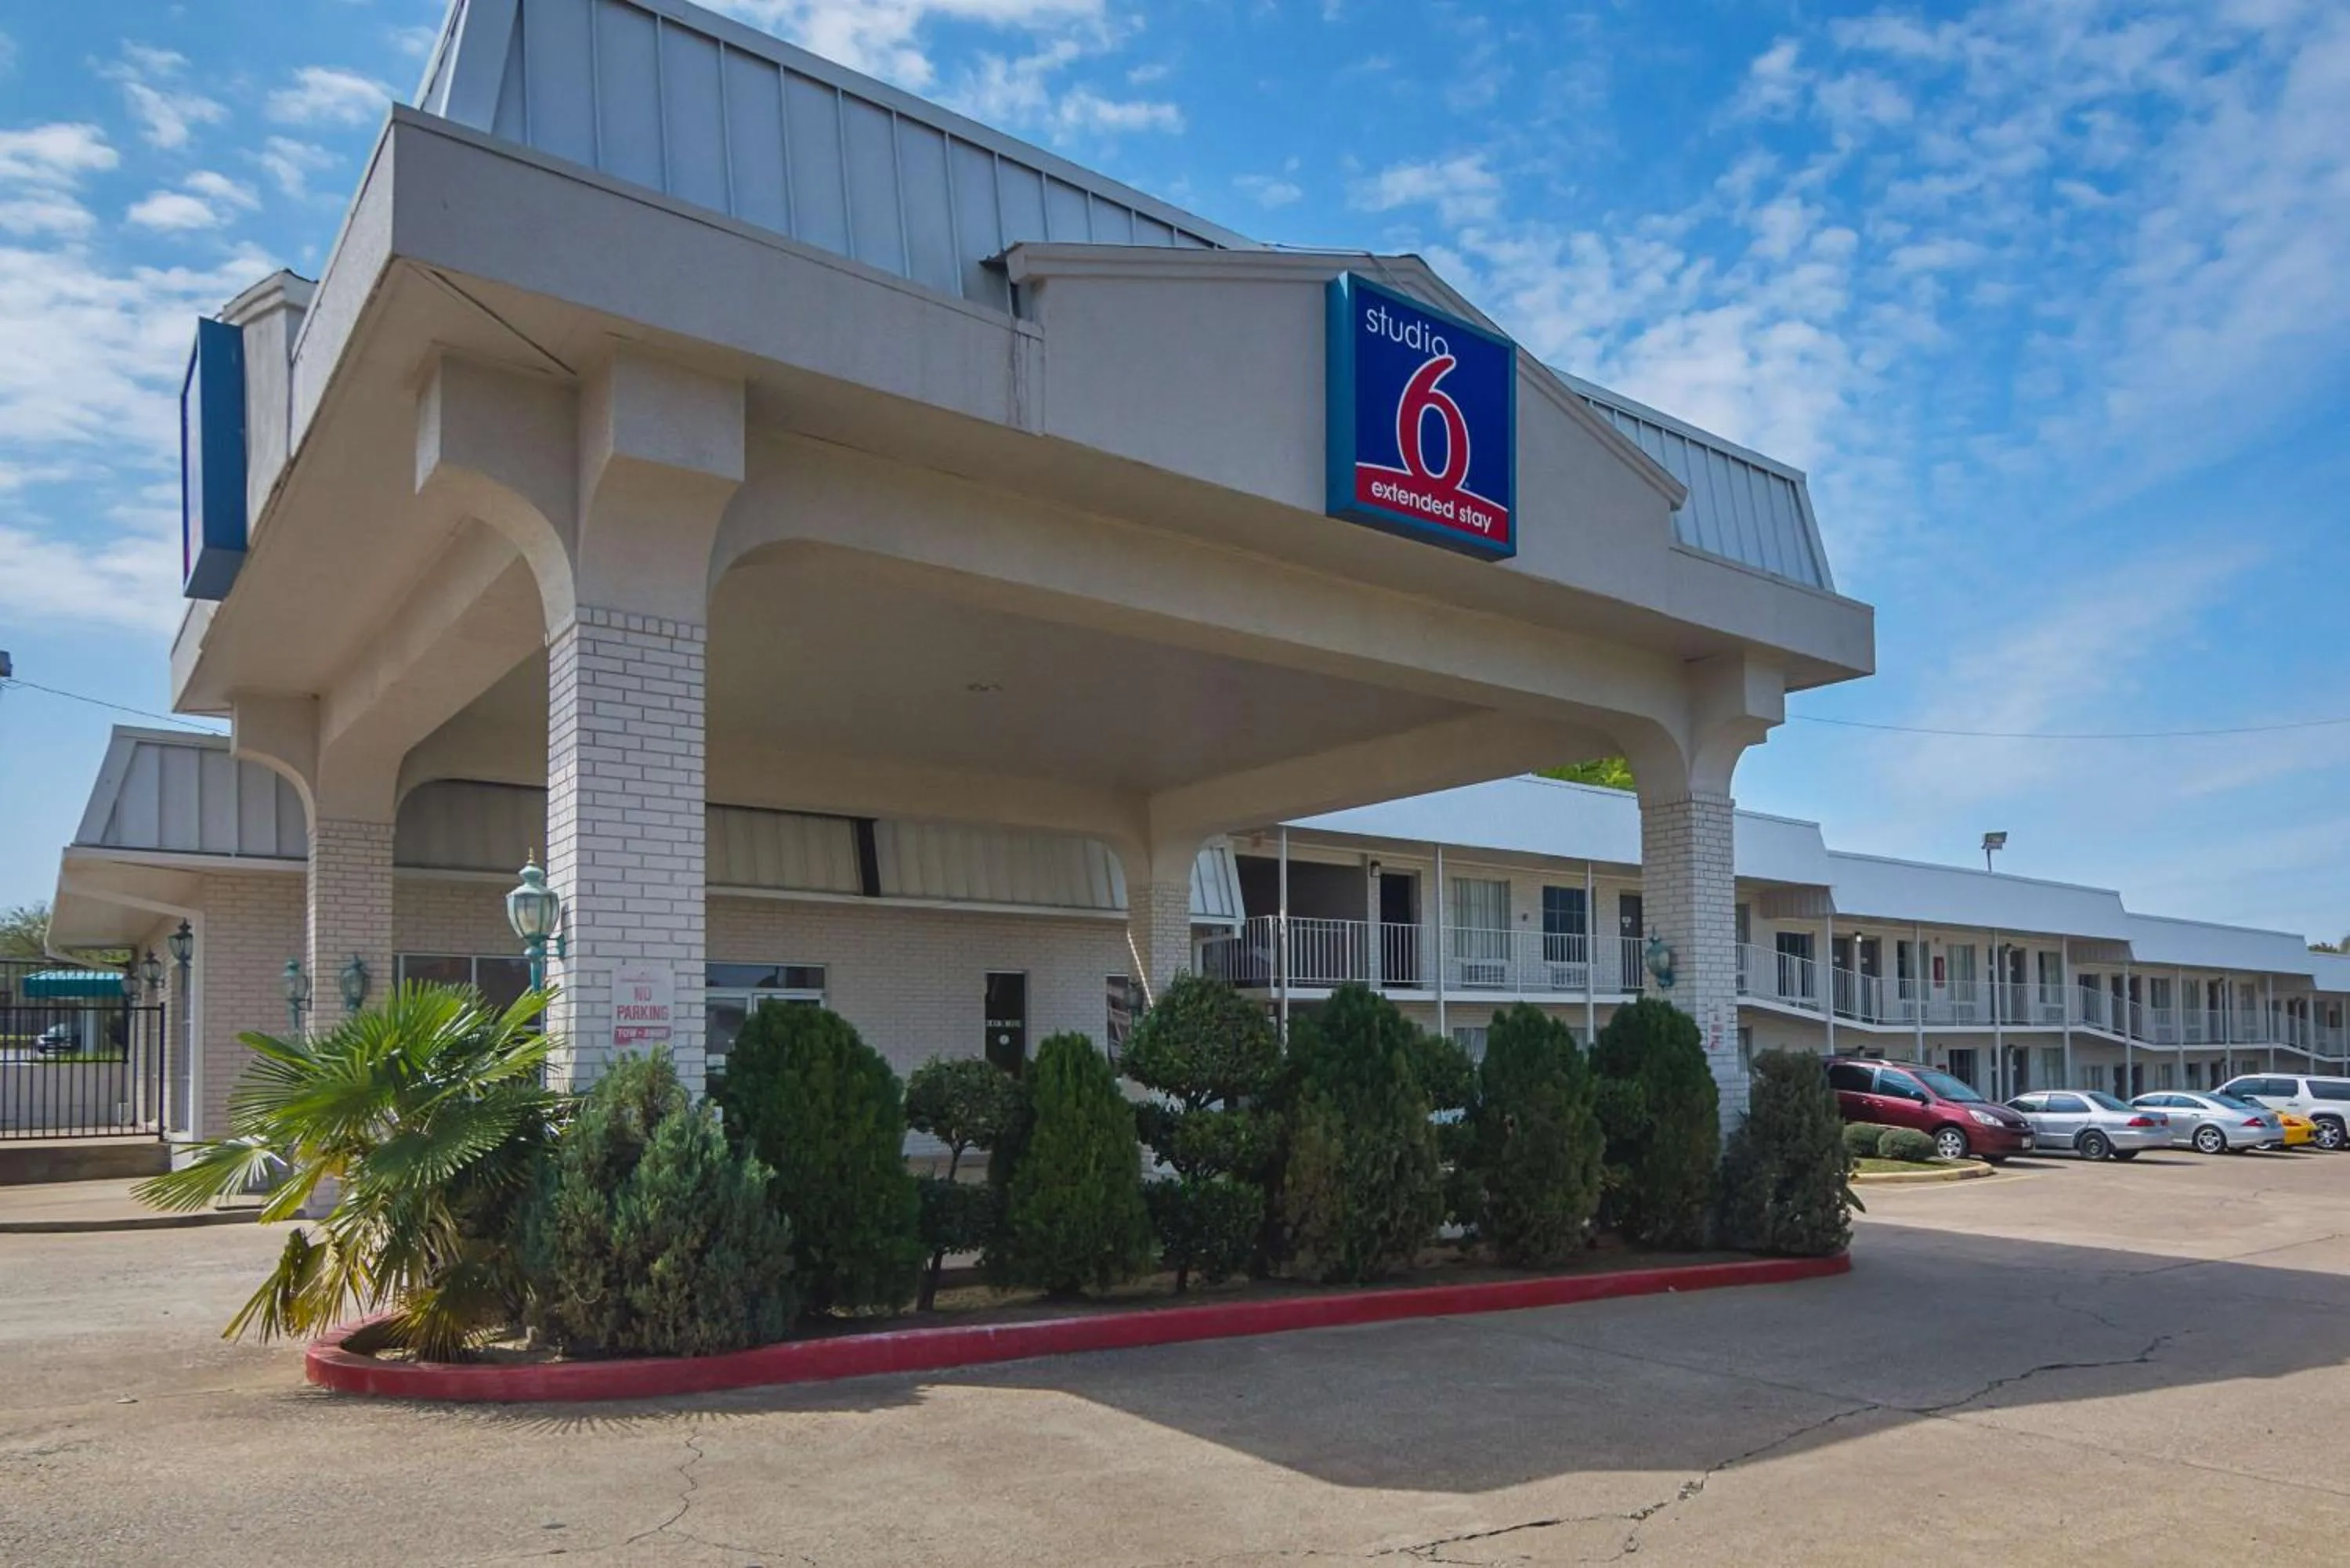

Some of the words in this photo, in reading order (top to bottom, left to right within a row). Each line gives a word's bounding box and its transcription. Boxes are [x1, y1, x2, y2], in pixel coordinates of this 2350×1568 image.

[1366, 307, 1448, 356] studio
[1396, 354, 1470, 489] 6
[1372, 480, 1455, 519] extended
[1459, 505, 1493, 534] stay
[616, 1005, 669, 1021] PARKING
[633, 985, 653, 1002] NO
